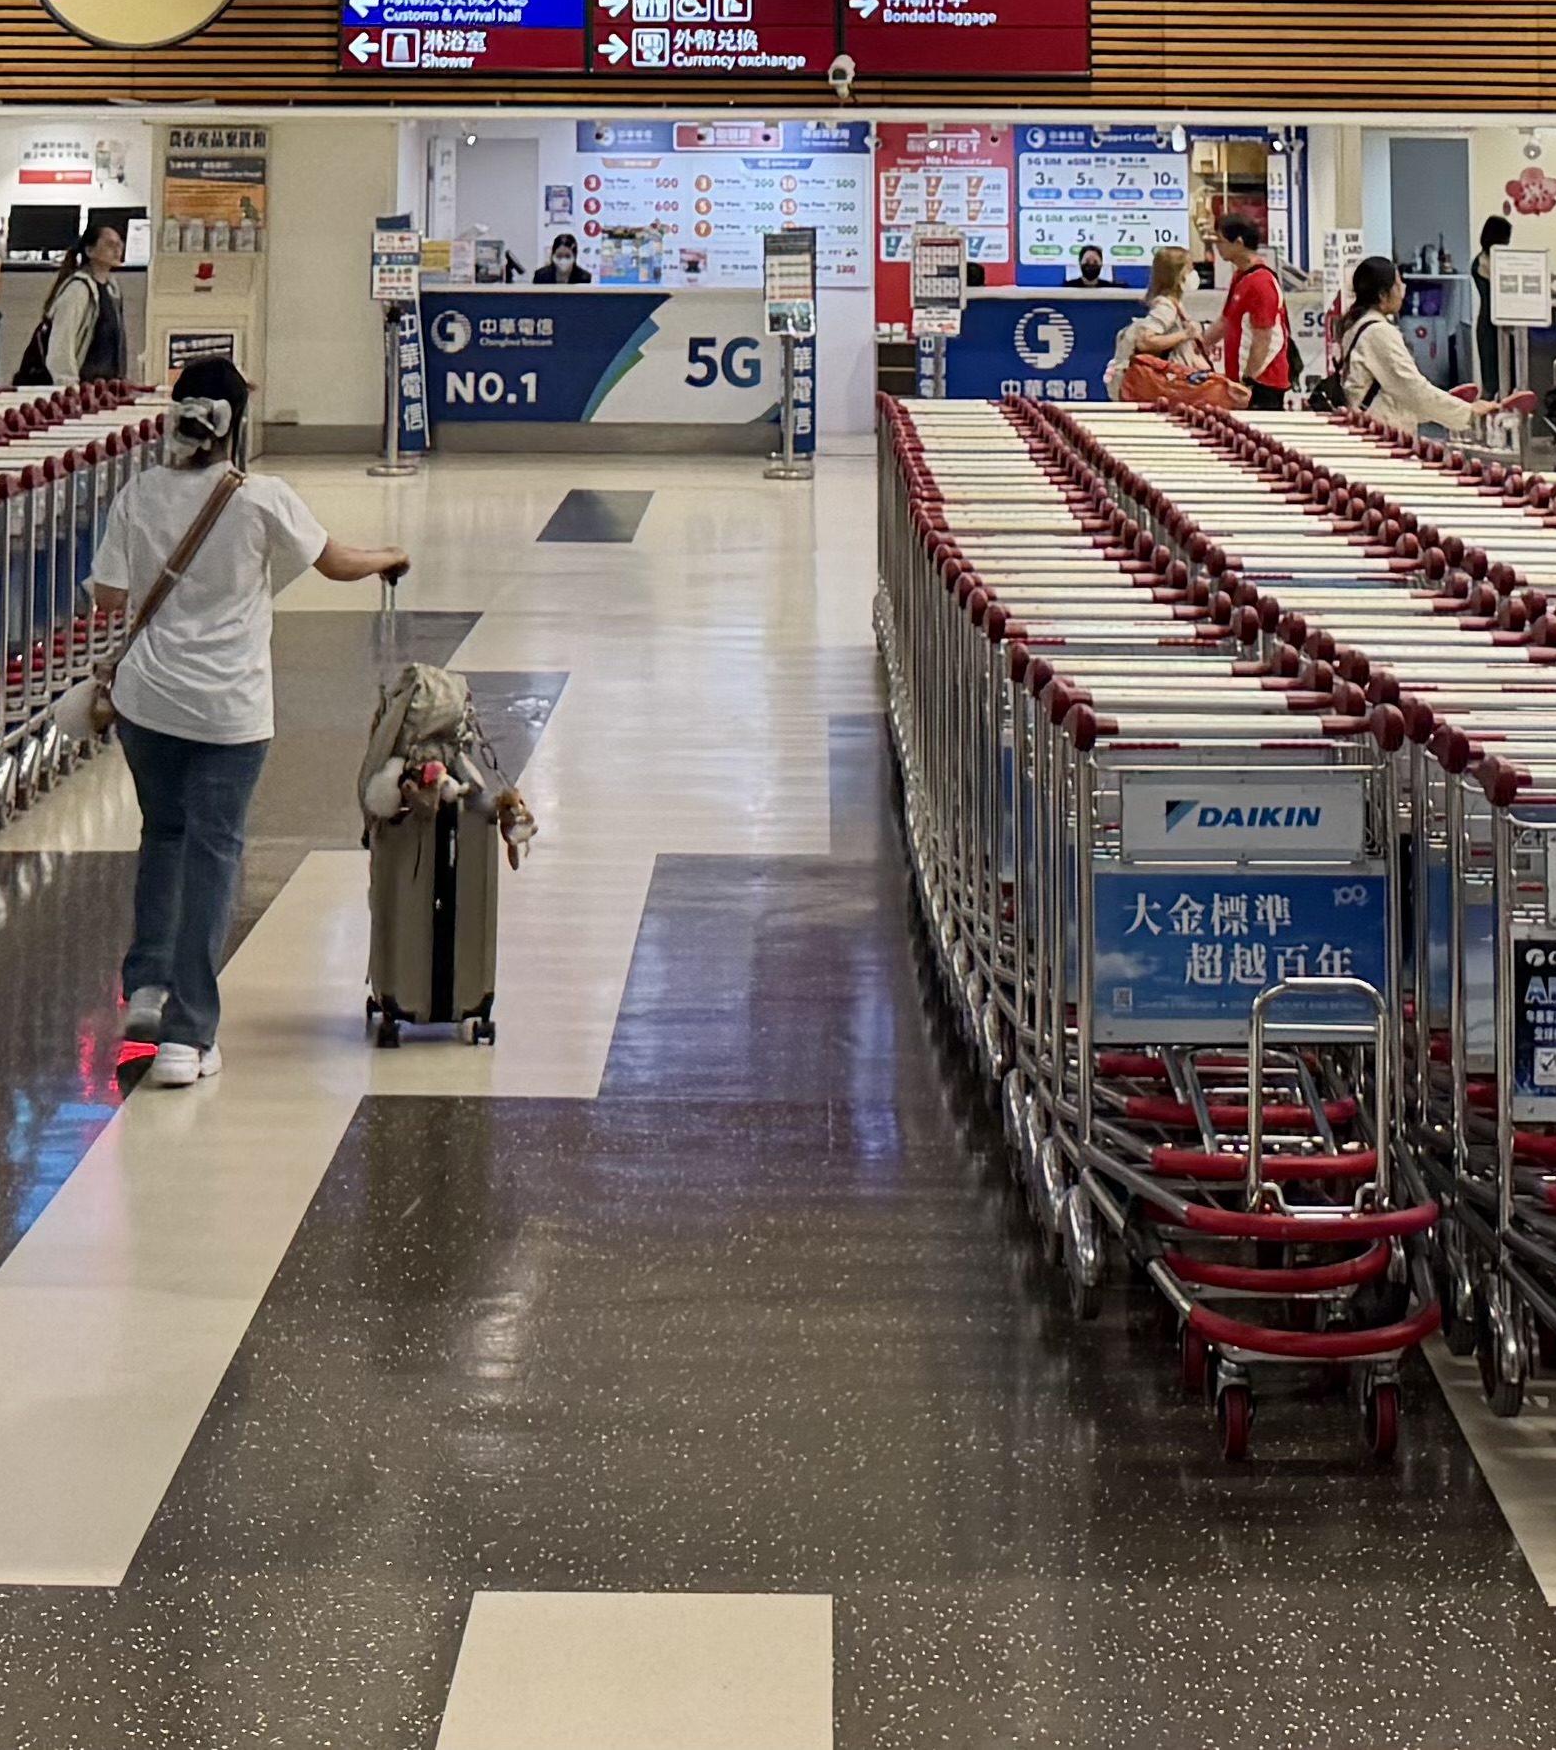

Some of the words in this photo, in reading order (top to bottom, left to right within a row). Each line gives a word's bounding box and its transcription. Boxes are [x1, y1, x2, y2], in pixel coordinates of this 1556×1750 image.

[383, 9, 438, 22] Customs
[456, 9, 494, 22] Arrival
[498, 8, 521, 22] hall
[883, 9, 935, 23] Bonded
[938, 10, 996, 26] baggage
[421, 54, 474, 69] Shower
[672, 54, 735, 69] Currency
[738, 54, 806, 69] exchange
[685, 337, 761, 388] 5G
[446, 371, 537, 403] NO.1
[1197, 806, 1321, 828] DAIKIN
[1123, 892, 1293, 937] 大金標準
